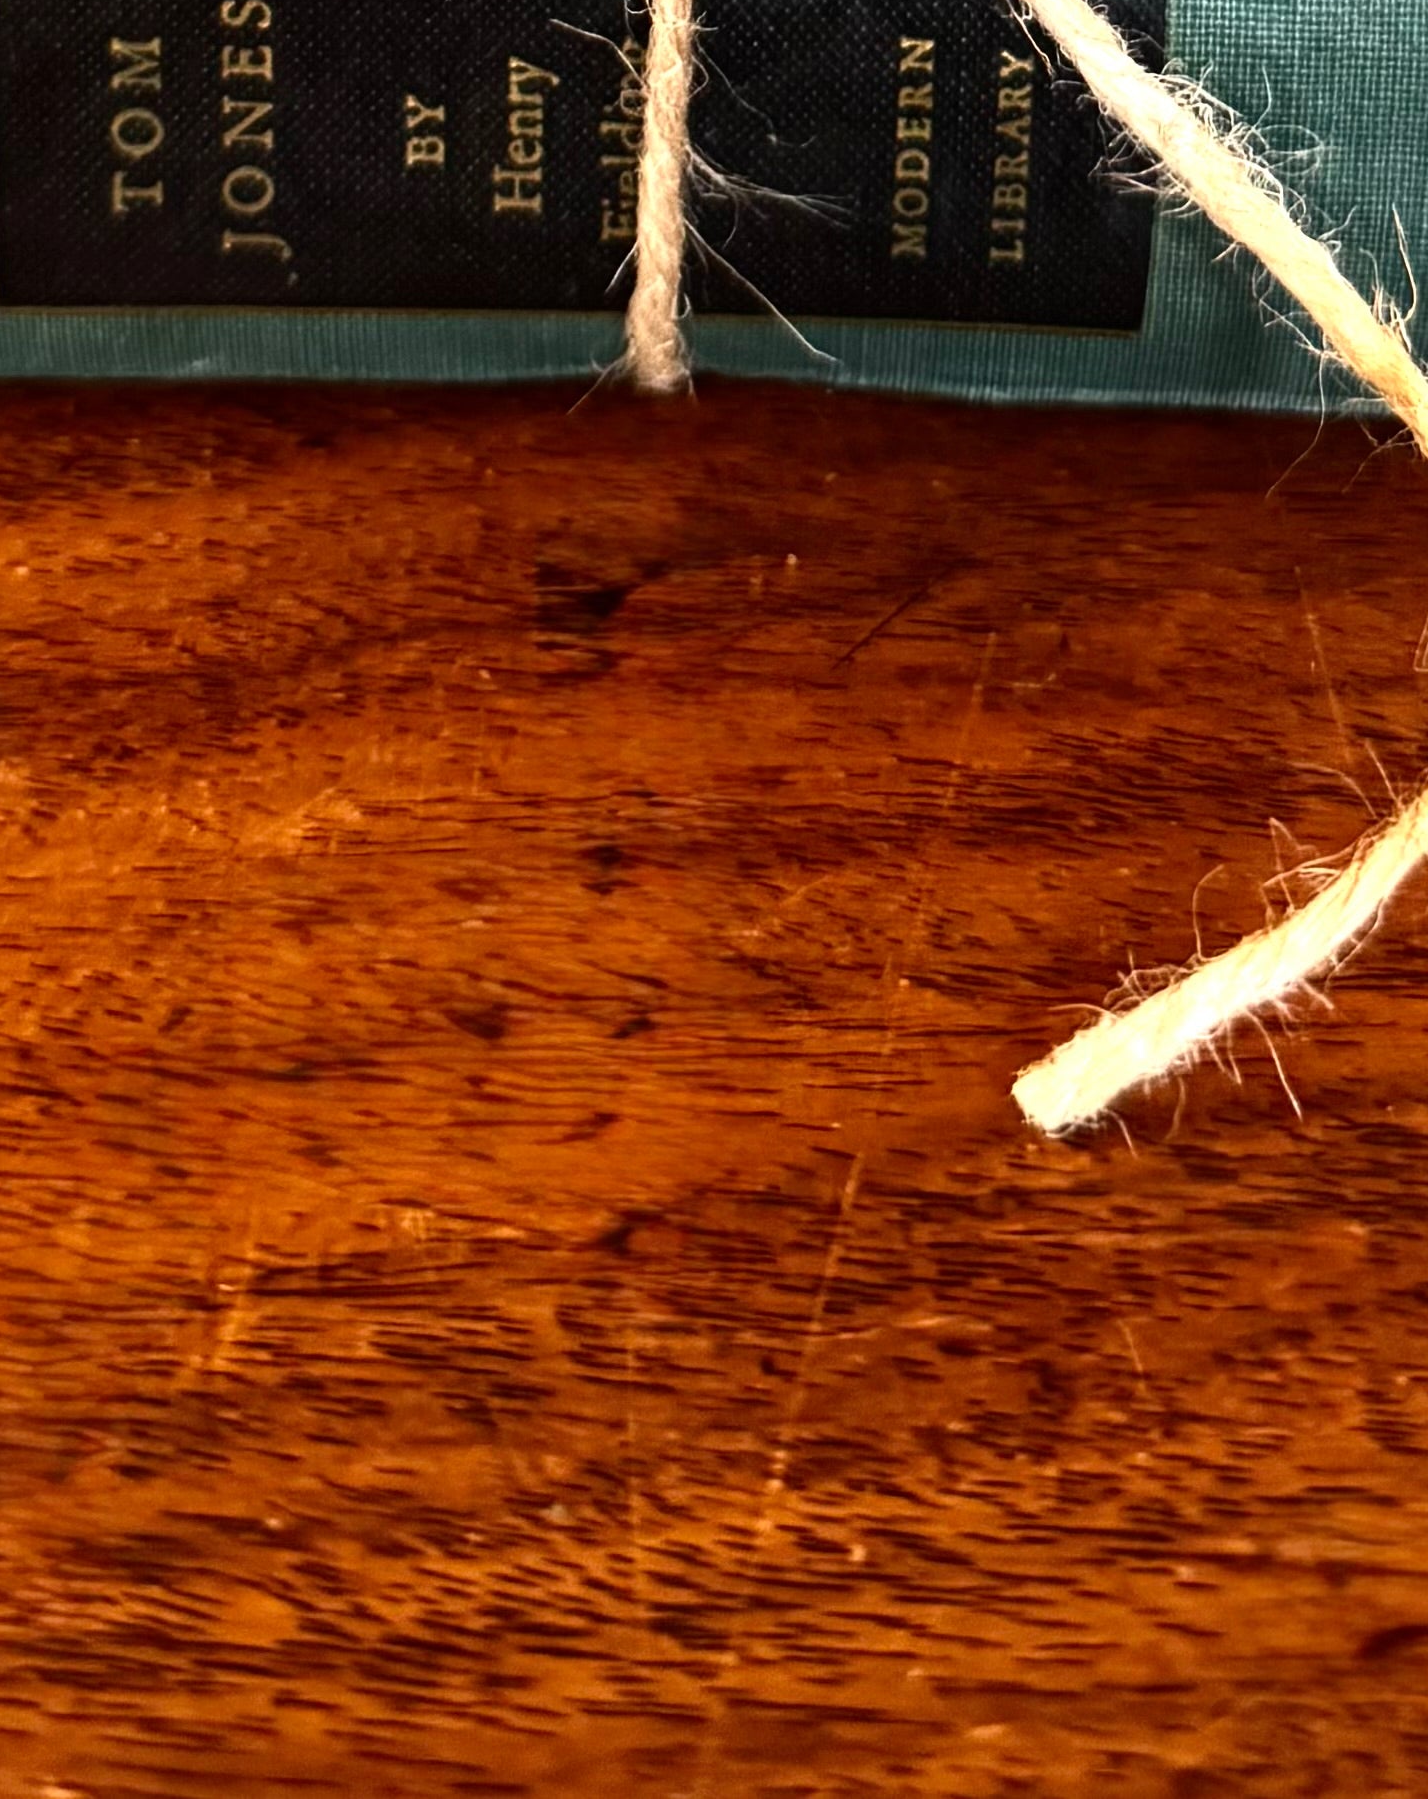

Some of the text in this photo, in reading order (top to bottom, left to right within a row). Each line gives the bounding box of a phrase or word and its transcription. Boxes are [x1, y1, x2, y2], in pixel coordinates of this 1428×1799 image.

[109, 36, 165, 214] TOM
[404, 94, 446, 167] BY
[492, 56, 561, 213] Henry
[892, 35, 935, 258] MODERN
[988, 50, 1033, 264] LIBRARY
